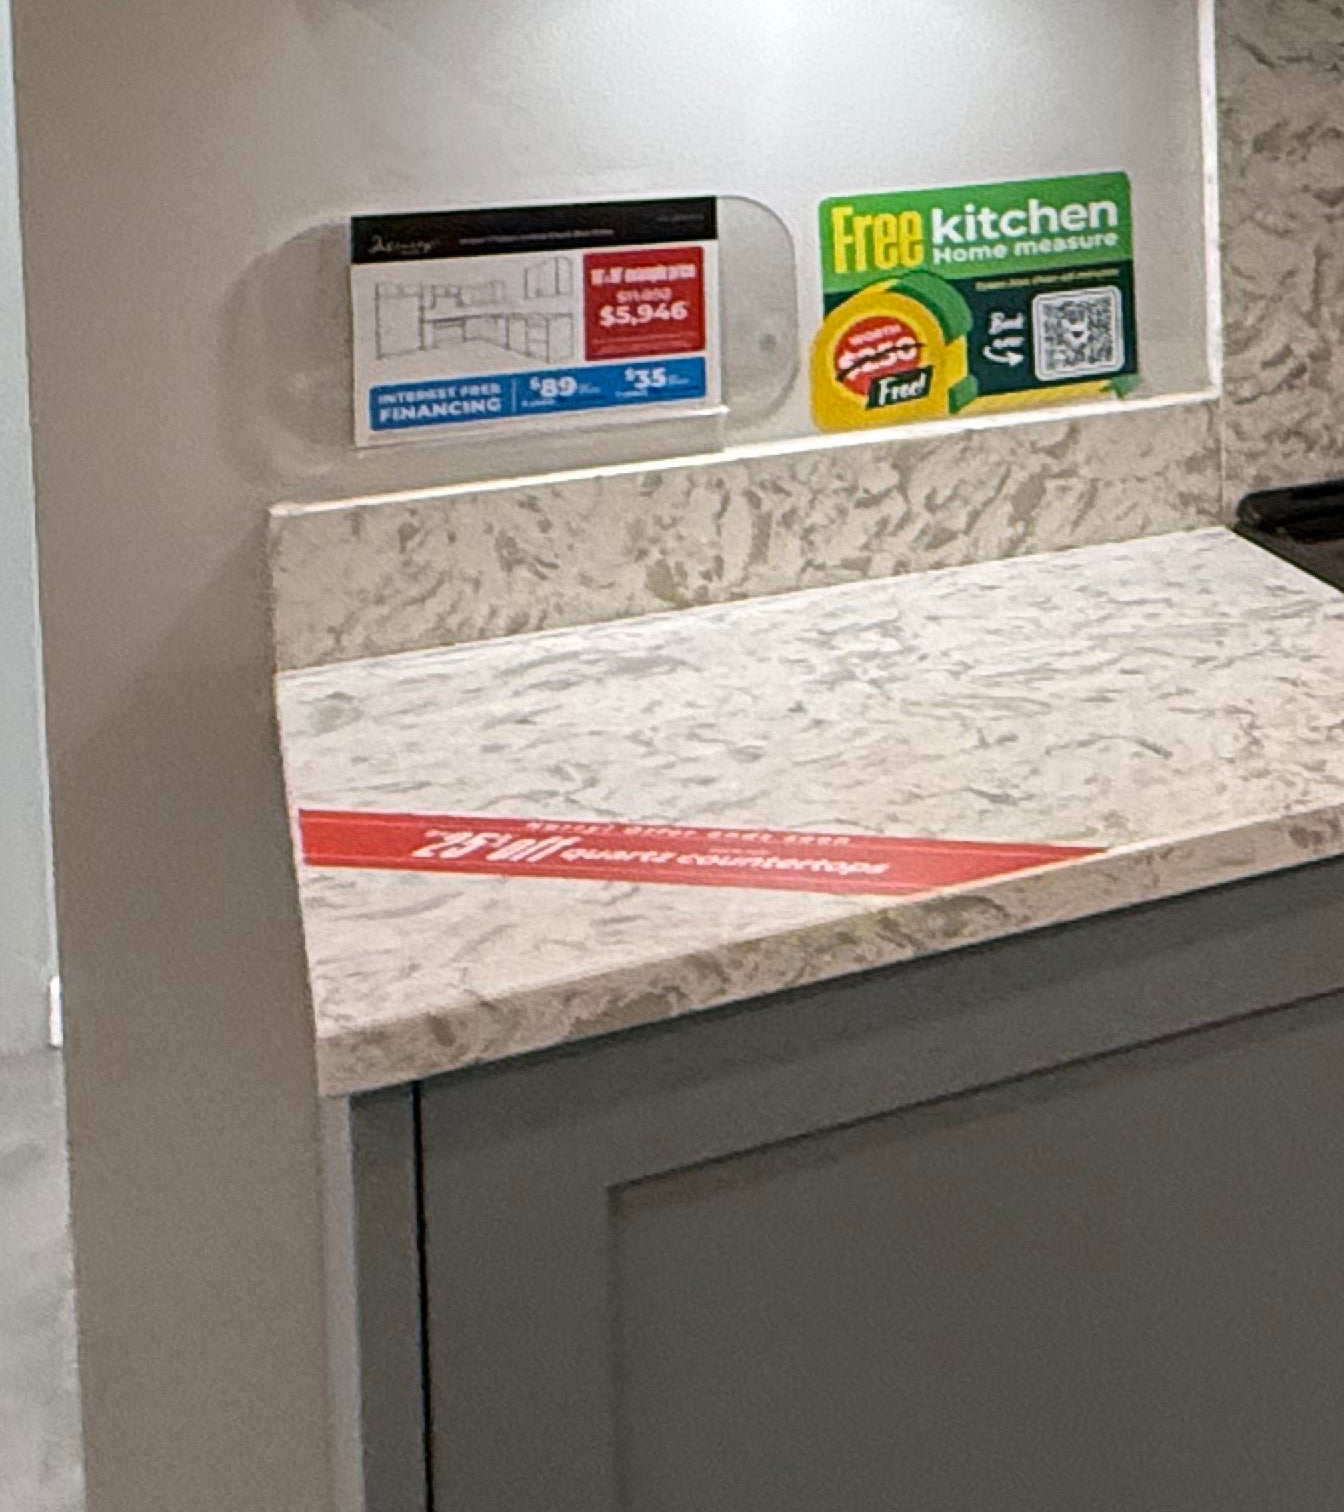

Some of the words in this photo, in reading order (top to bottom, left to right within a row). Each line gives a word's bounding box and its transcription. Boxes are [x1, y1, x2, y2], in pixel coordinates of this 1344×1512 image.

[831, 206, 922, 273] Free
[931, 199, 1118, 245] kitchen
[932, 244, 1007, 265] Home
[1014, 232, 1118, 257] measure
[600, 299, 690, 326] $5,946
[379, 396, 501, 423] FINANCING
